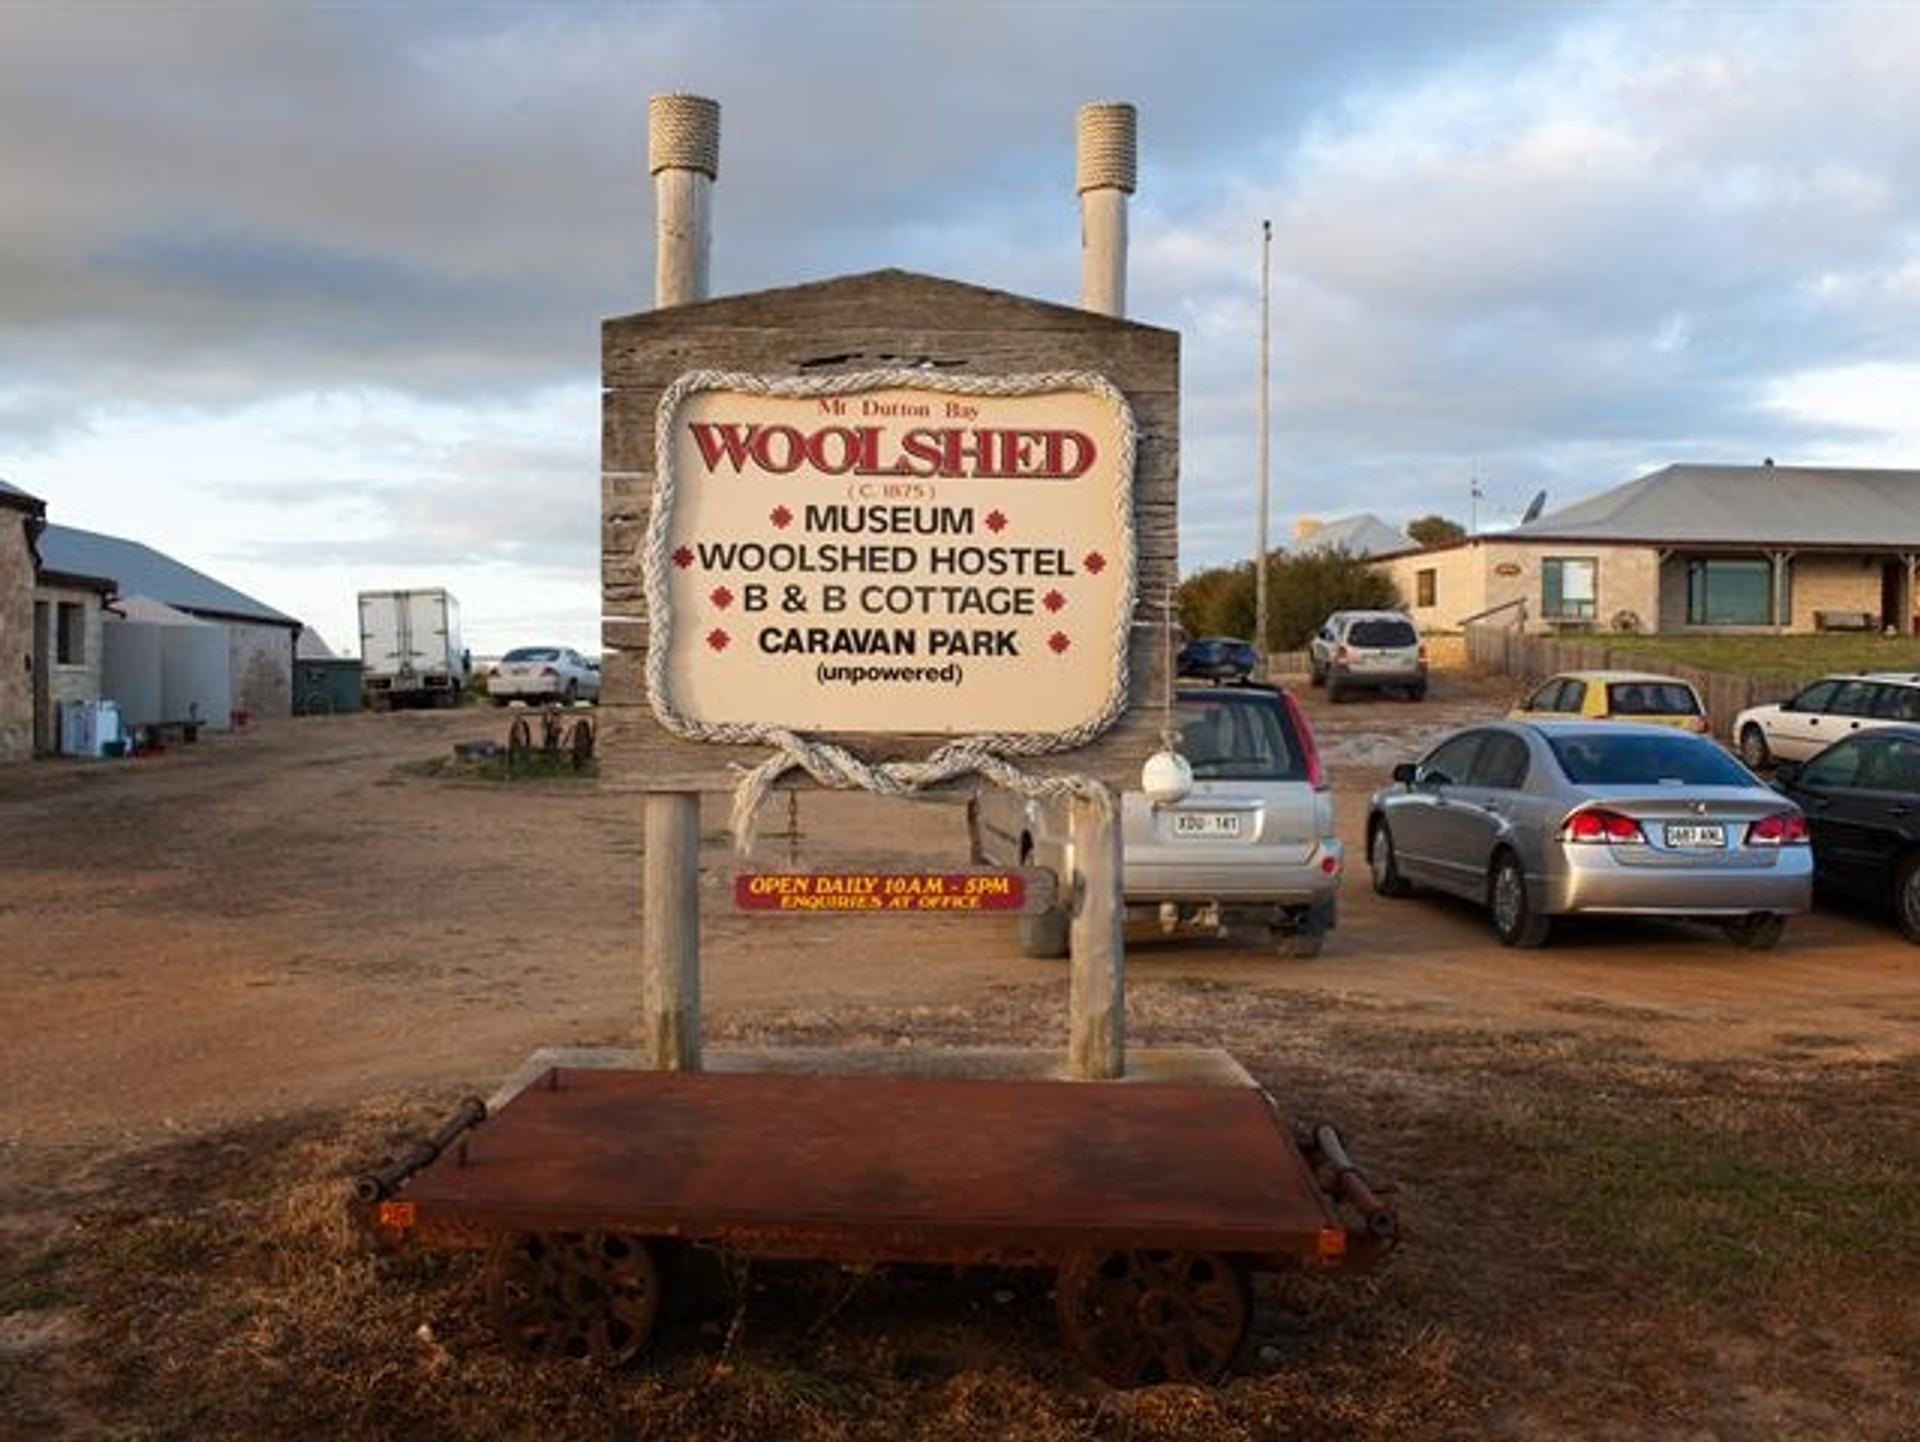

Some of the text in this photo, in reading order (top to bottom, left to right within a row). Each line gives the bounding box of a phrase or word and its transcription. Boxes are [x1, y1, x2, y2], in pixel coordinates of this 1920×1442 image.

[818, 399, 979, 421] Mt Dutton Bay
[688, 421, 1097, 479] WOOLSHED
[805, 504, 974, 534] MUSEUM
[697, 543, 1075, 576] WOOLSHED HOSTEL
[744, 584, 1035, 615] B & B COTTAGE
[758, 627, 1020, 657] CARAVAN PARK
[817, 662, 963, 686] (unpowered)
[750, 877, 808, 894] OPEN
[815, 877, 878, 894] DAILY
[884, 877, 943, 894] 10AM
[964, 877, 1010, 895] 5PM
[781, 895, 981, 909] ENQUIRIES AT OFFICE
